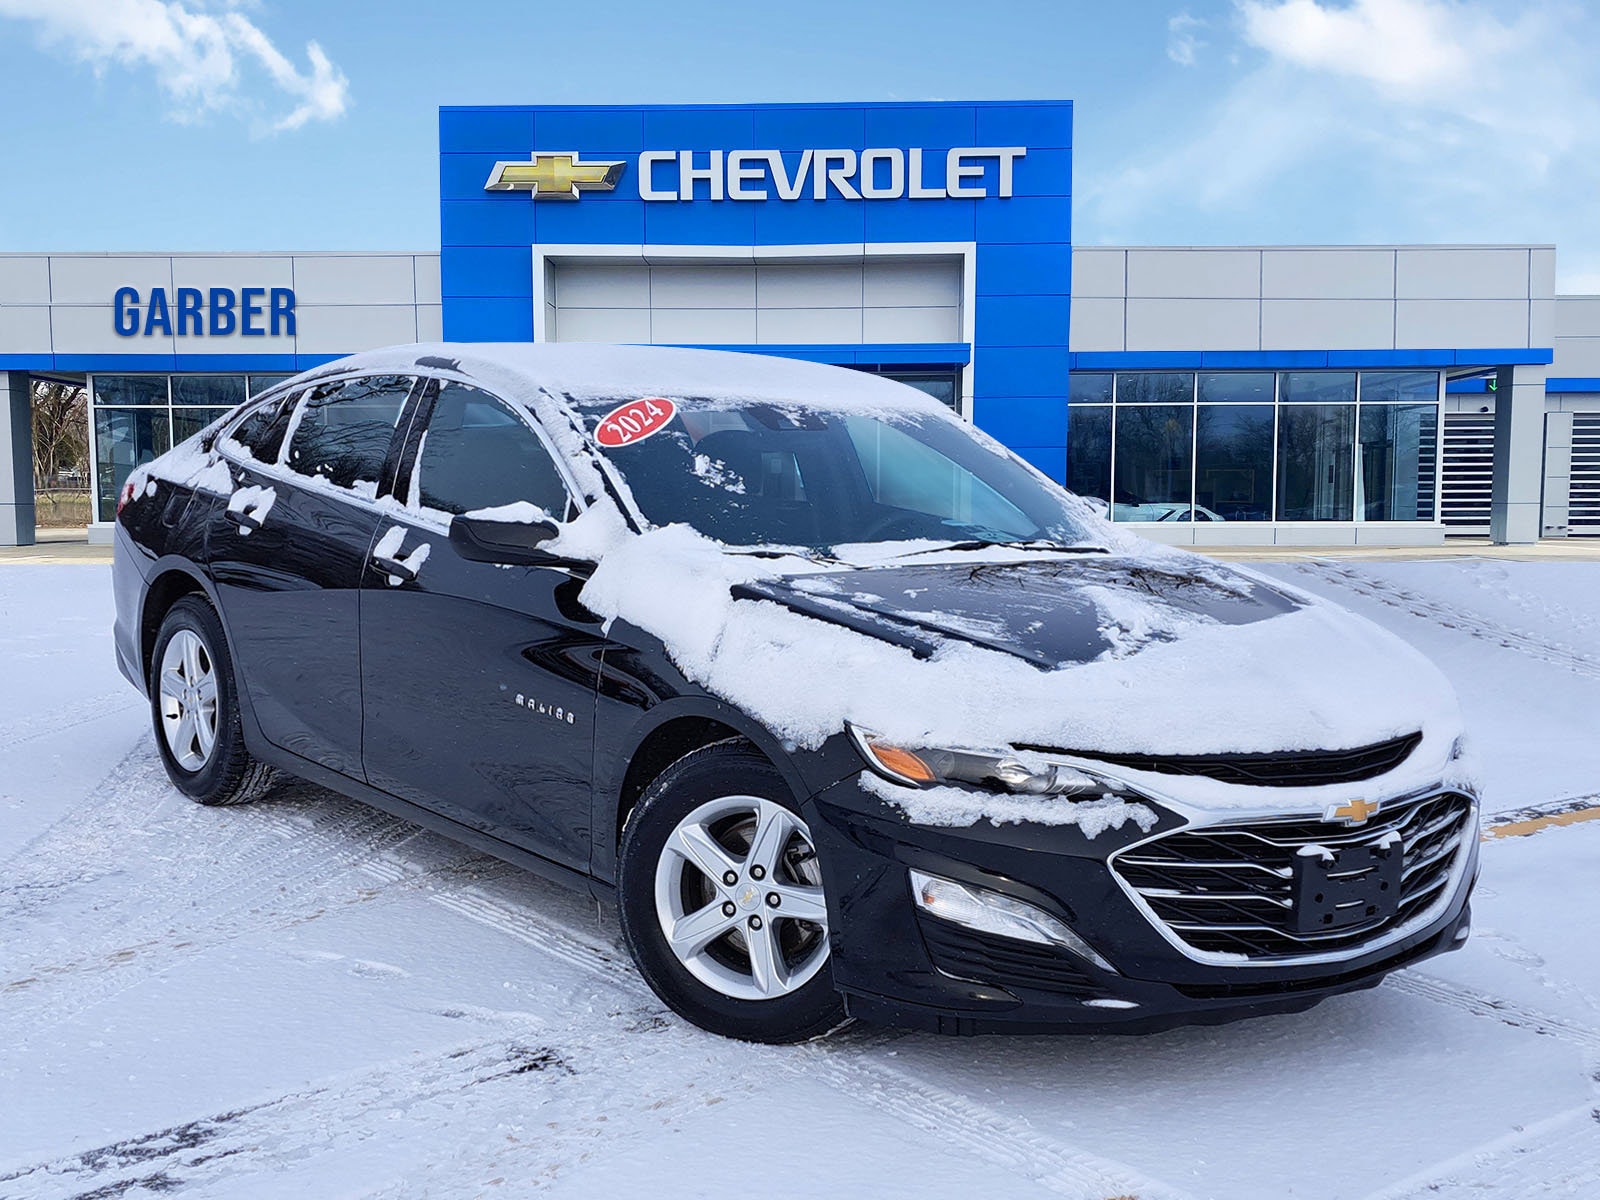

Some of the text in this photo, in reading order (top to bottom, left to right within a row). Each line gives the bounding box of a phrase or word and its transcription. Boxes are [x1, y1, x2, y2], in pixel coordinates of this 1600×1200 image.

[638, 146, 1027, 202] CHEVROLET
[114, 286, 297, 337] GARBER
[606, 400, 664, 442] 2024
